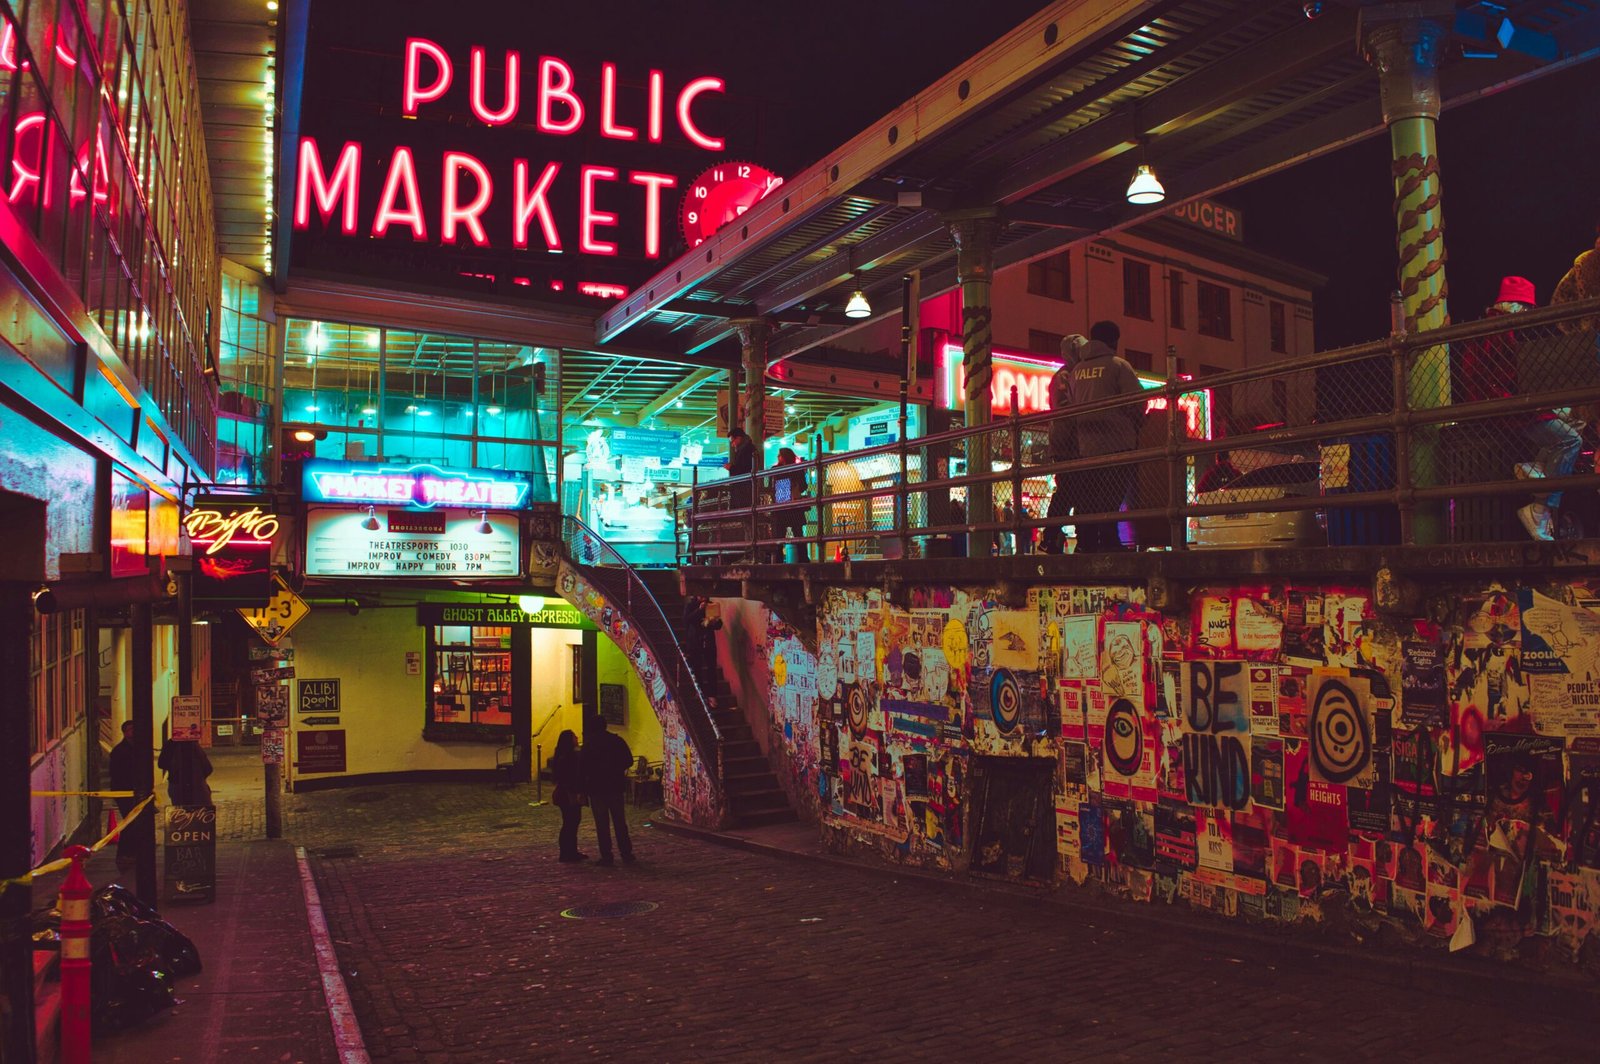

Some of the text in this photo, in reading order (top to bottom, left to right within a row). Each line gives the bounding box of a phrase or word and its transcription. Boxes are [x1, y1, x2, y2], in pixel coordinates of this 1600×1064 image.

[402, 37, 725, 150] PUBLIC
[714, 170, 724, 182] 11
[738, 166, 750, 178] 12
[294, 136, 676, 259] MARKET
[695, 186, 707, 199] 10
[687, 212, 698, 224] 9
[1174, 201, 1236, 236] DUCER
[1074, 366, 1104, 381] VALET
[320, 475, 518, 503] MARKET THEATER
[183, 506, 279, 555] Bistro
[369, 541, 469, 551] THEATRESPORTS 1030
[368, 552, 491, 561] IMPROV COMEDY 830PM
[347, 562, 482, 571] IMPROV HAPPY HOUR 7PM
[443, 608, 581, 624] GHOST ALLEY ESPRESSO
[1586, 671, 1592, 681] A
[304, 683, 335, 695] ALIBI
[1189, 662, 1242, 733] BE
[1571, 694, 1600, 705] HISTOR
[1183, 733, 1250, 811] KIND
[1309, 789, 1342, 806] HEIGHTS
[171, 832, 211, 842] OPEN
[1208, 841, 1223, 856] KISS
